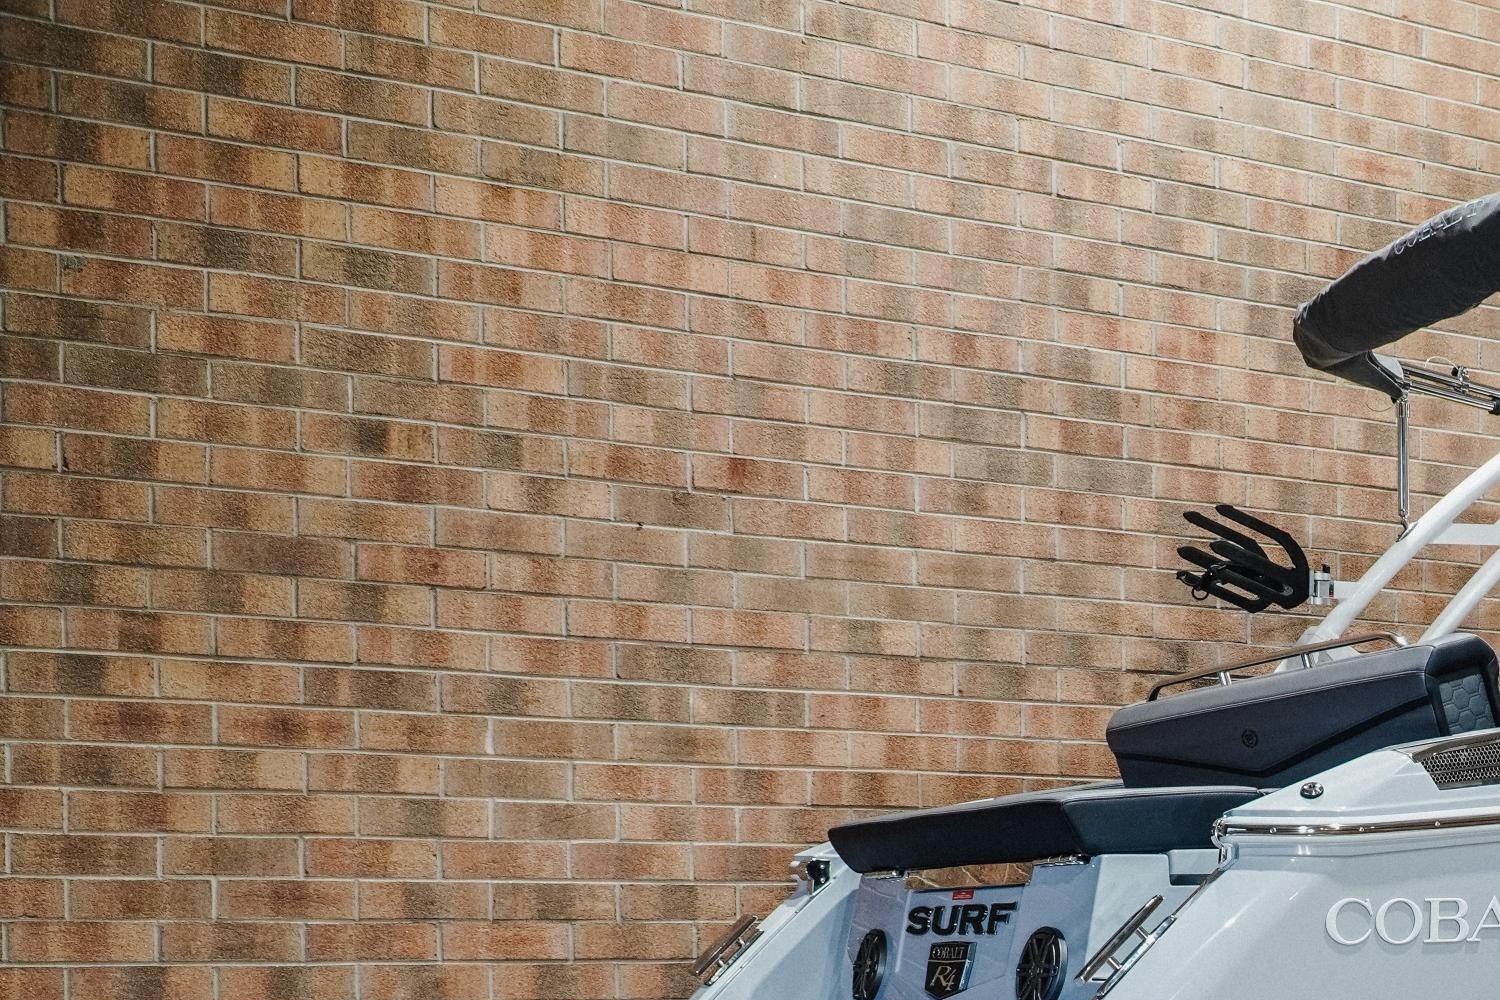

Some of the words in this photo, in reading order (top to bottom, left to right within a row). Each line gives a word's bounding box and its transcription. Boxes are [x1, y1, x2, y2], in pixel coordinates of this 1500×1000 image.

[906, 902, 1018, 936] SURF
[932, 946, 965, 959] COBALT
[930, 965, 957, 991] R4
